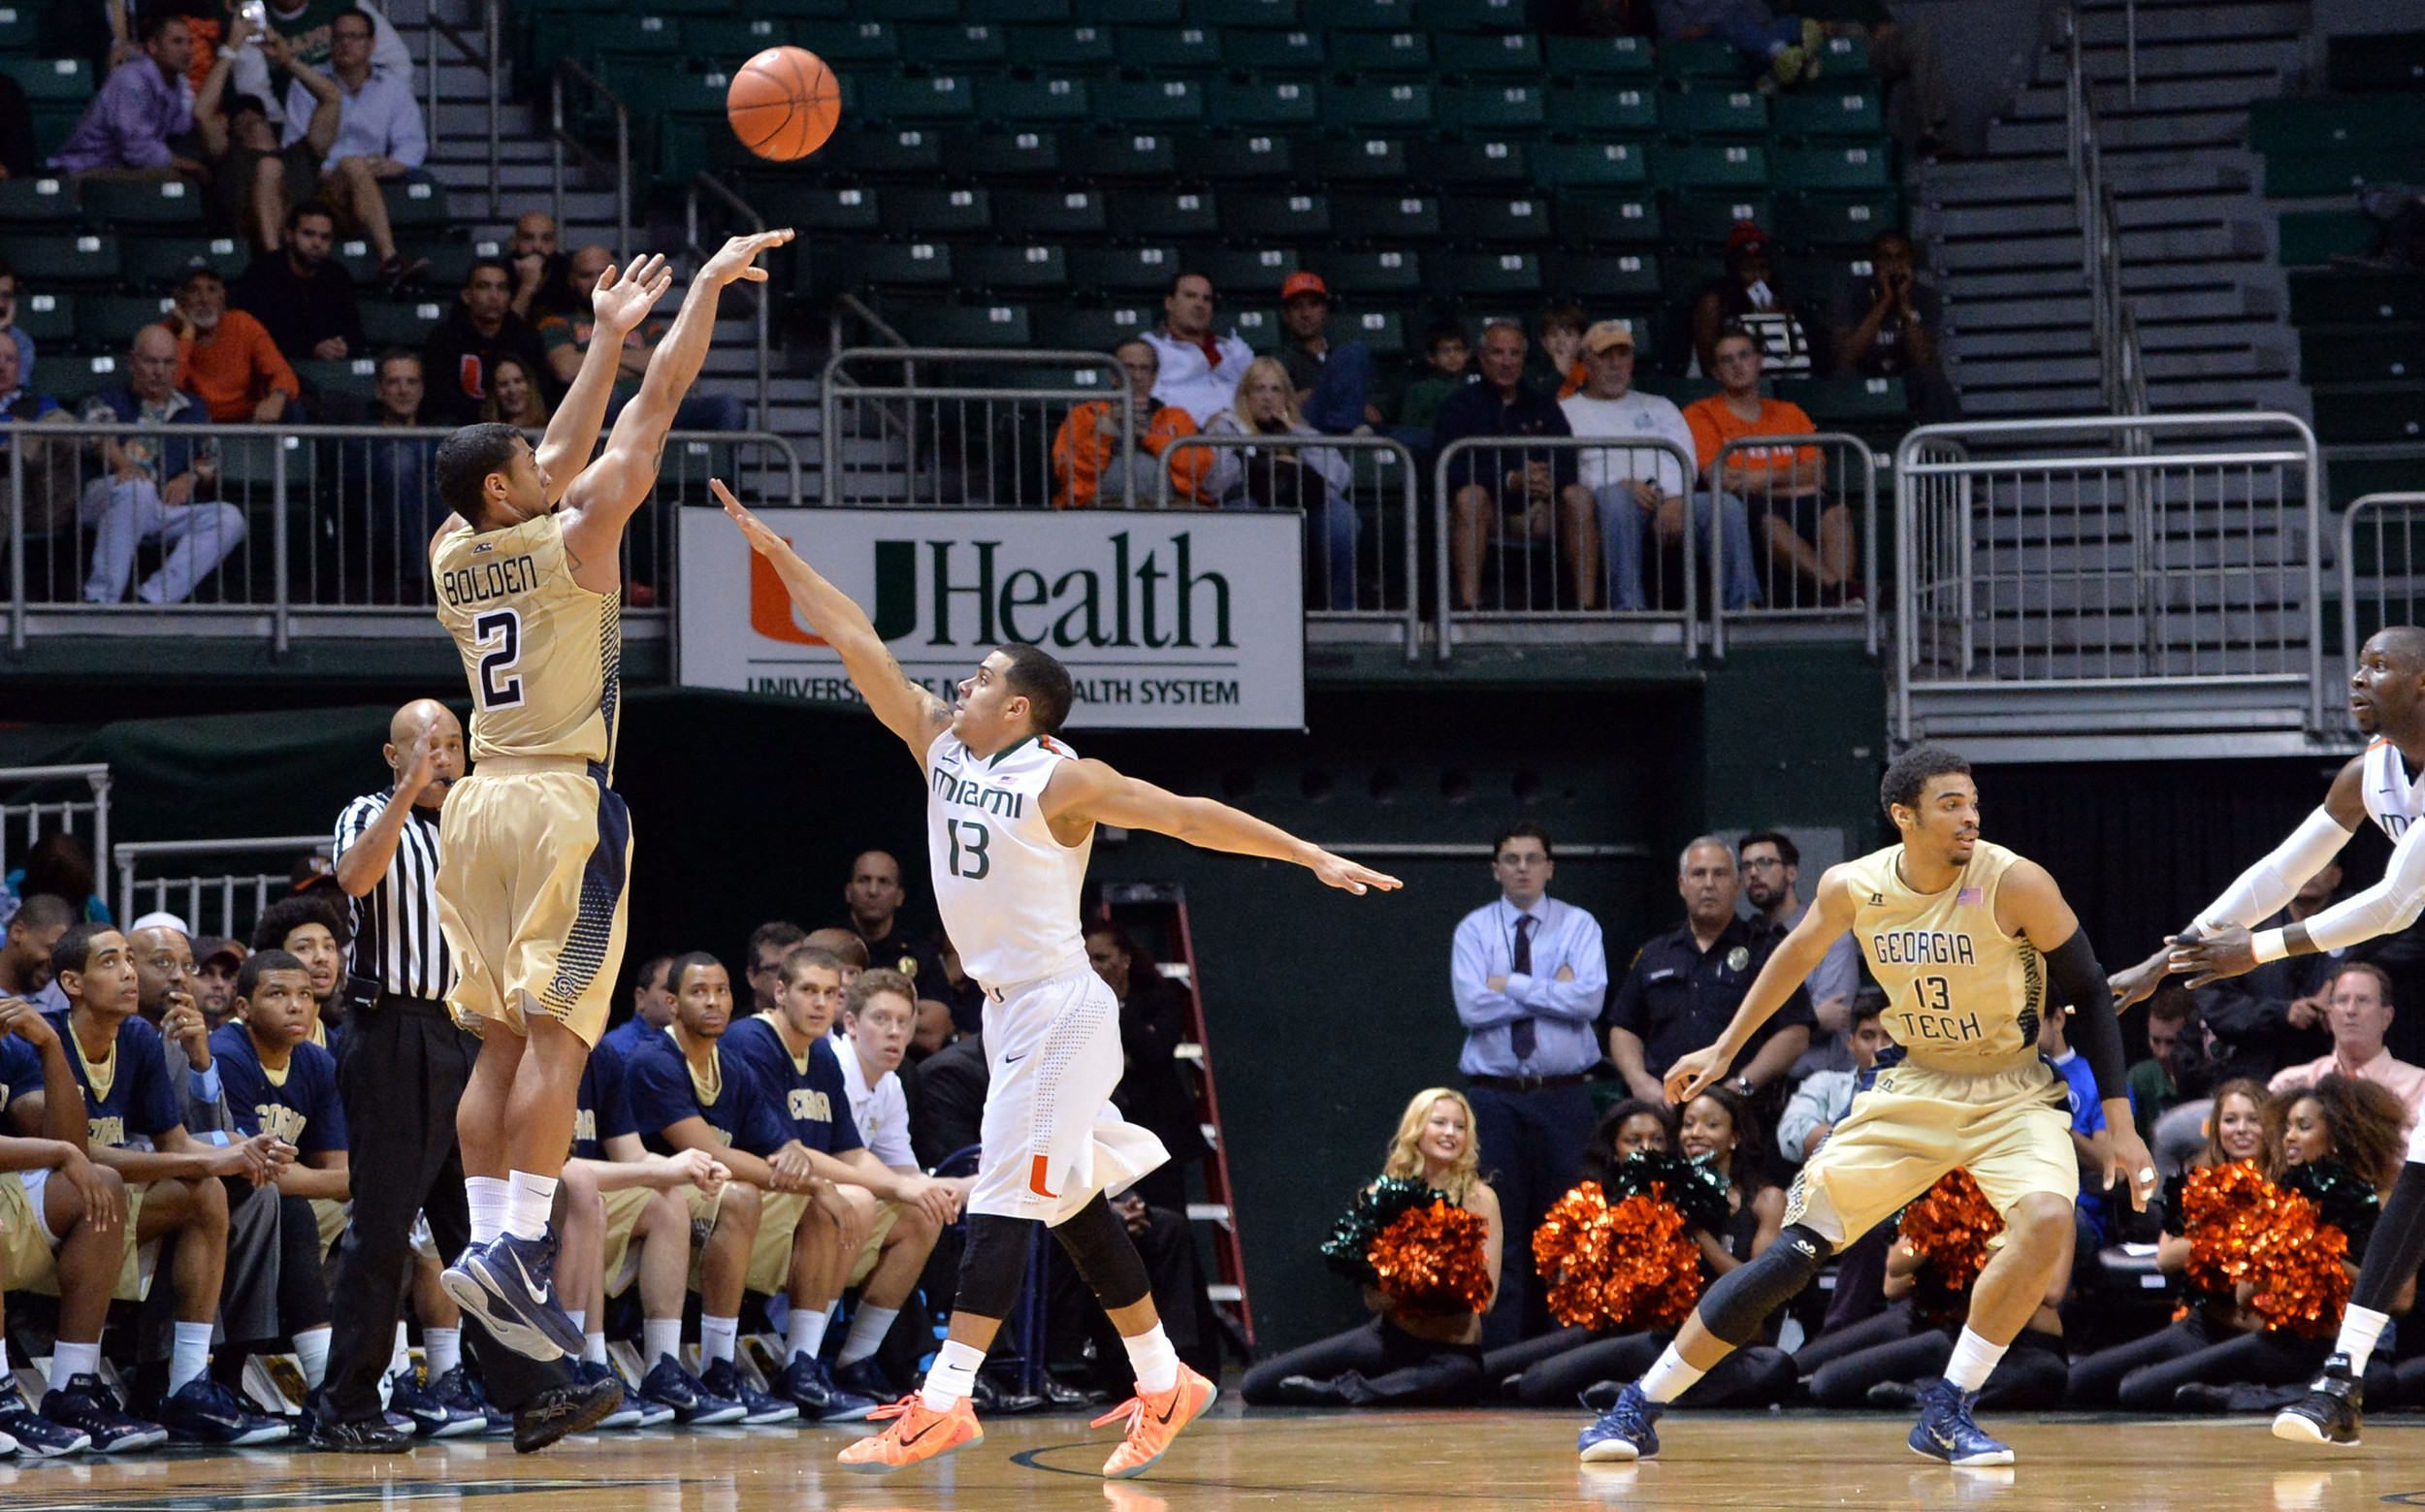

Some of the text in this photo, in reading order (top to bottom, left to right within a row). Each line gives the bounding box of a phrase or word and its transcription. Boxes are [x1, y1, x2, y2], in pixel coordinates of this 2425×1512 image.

[443, 555, 537, 606] BOLDEN
[474, 607, 525, 712] 2
[1072, 680, 1132, 703] ALTH
[1140, 681, 1239, 704] SYSTEM
[948, 818, 989, 880] 13
[1873, 931, 1976, 966] GEORGIA
[1914, 976, 1951, 1011] 13
[1898, 1012, 1983, 1042] TECH
